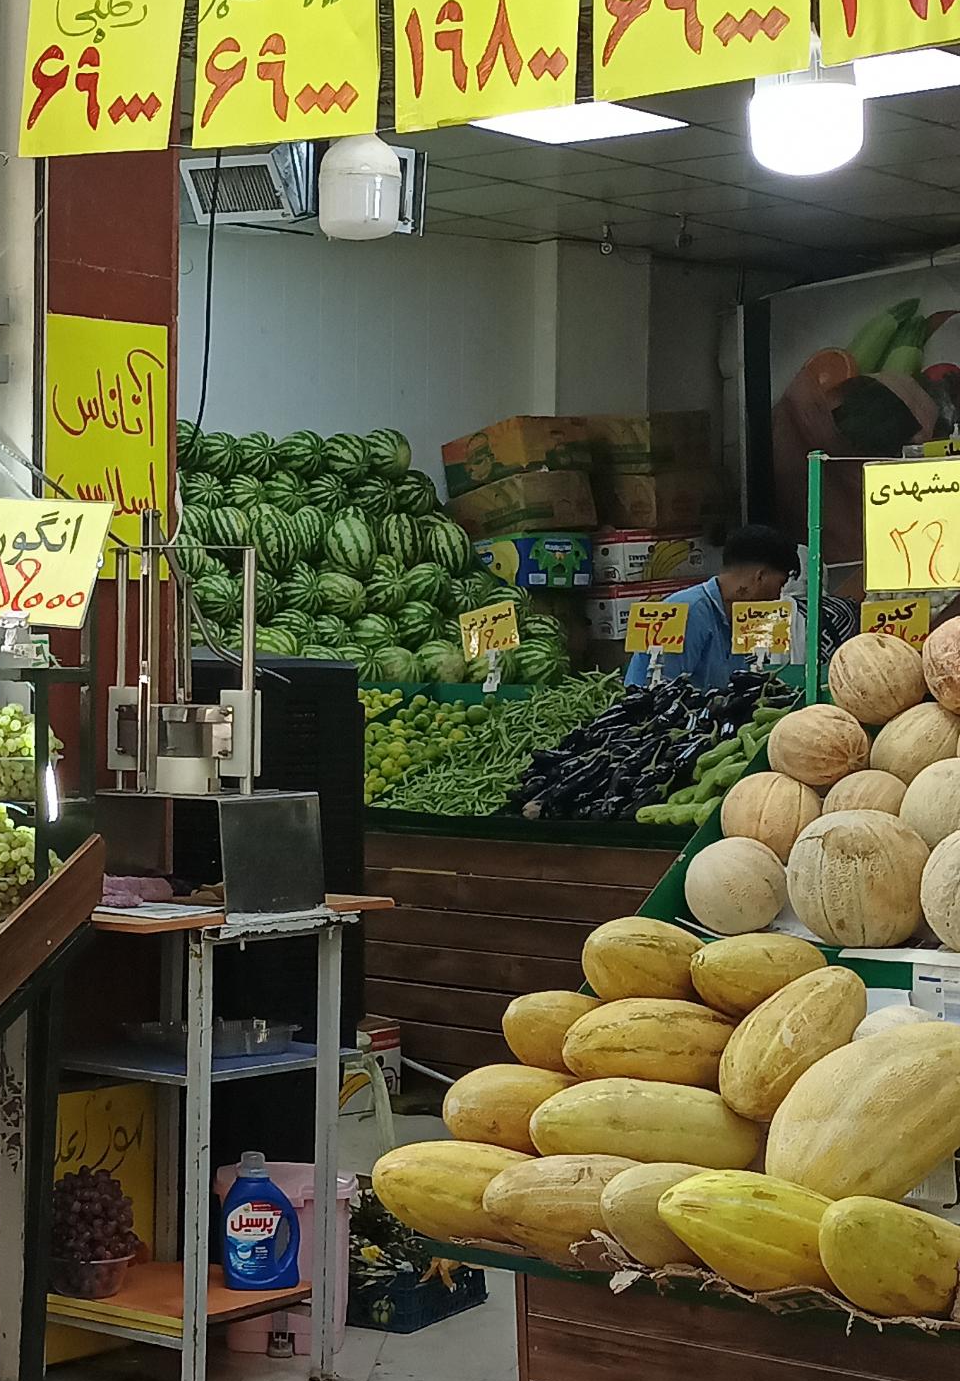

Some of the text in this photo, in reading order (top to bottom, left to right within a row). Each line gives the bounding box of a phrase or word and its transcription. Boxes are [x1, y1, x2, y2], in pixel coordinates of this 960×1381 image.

[26, 43, 163, 131] ۶۹۰۰۰
[200, 32, 359, 129] ۶۹۰۰۰
[52, 348, 164, 448] آناناس
[870, 473, 959, 506] مشهدی
[639, 607, 677, 622] لوبیا
[874, 602, 917, 628] کدو
[230, 1214, 274, 1235] پرسیل
